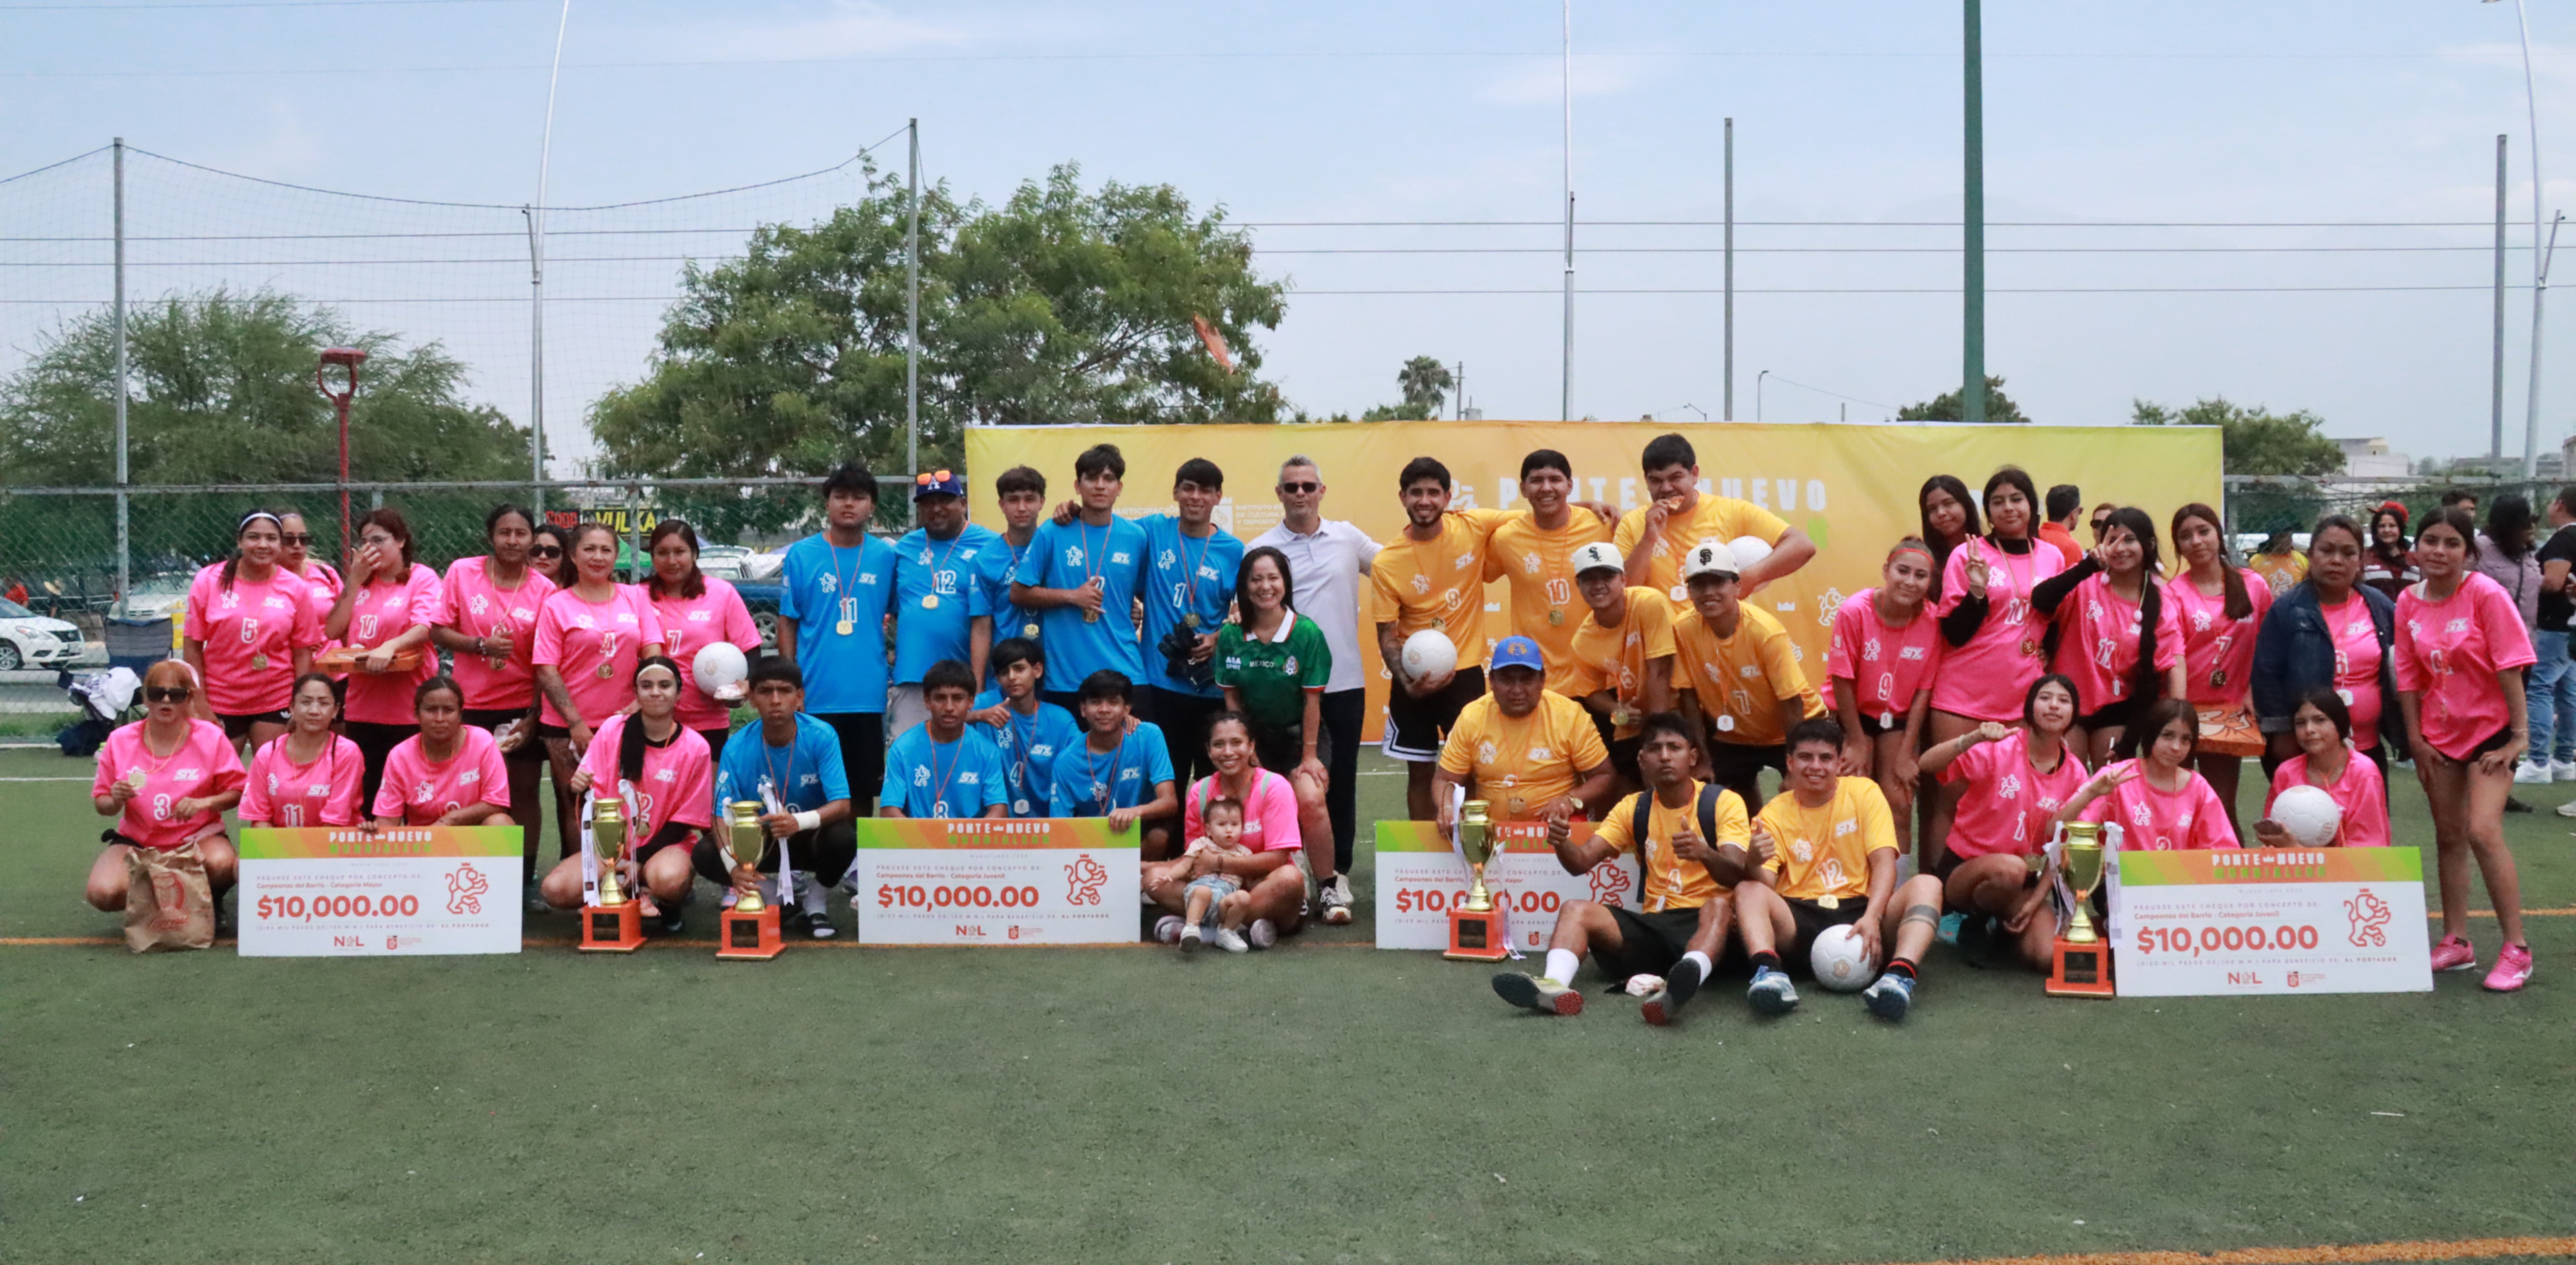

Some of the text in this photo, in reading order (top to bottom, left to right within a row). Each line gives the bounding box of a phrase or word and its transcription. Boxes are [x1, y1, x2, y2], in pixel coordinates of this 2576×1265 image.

[928, 475, 940, 490] A
[935, 570, 956, 594] 12
[1546, 578, 1570, 605] 10
[241, 618, 257, 644] 5
[359, 614, 378, 639] 10
[667, 630, 682, 655] 7
[1878, 673, 1893, 701] 9
[154, 793, 171, 821] 3
[329, 831, 432, 842] PONTE NUEVO
[948, 823, 1050, 833] PONTE NUEVO
[2212, 852, 2325, 866] PONTE NUEVO
[1667, 869, 1683, 894] 4
[1817, 858, 1848, 889] 12
[257, 895, 419, 923] $10,000.00
[878, 883, 1039, 912] $10,000.00
[1396, 888, 1560, 917] $10,00.00
[2137, 925, 2318, 958] $10,000.00
